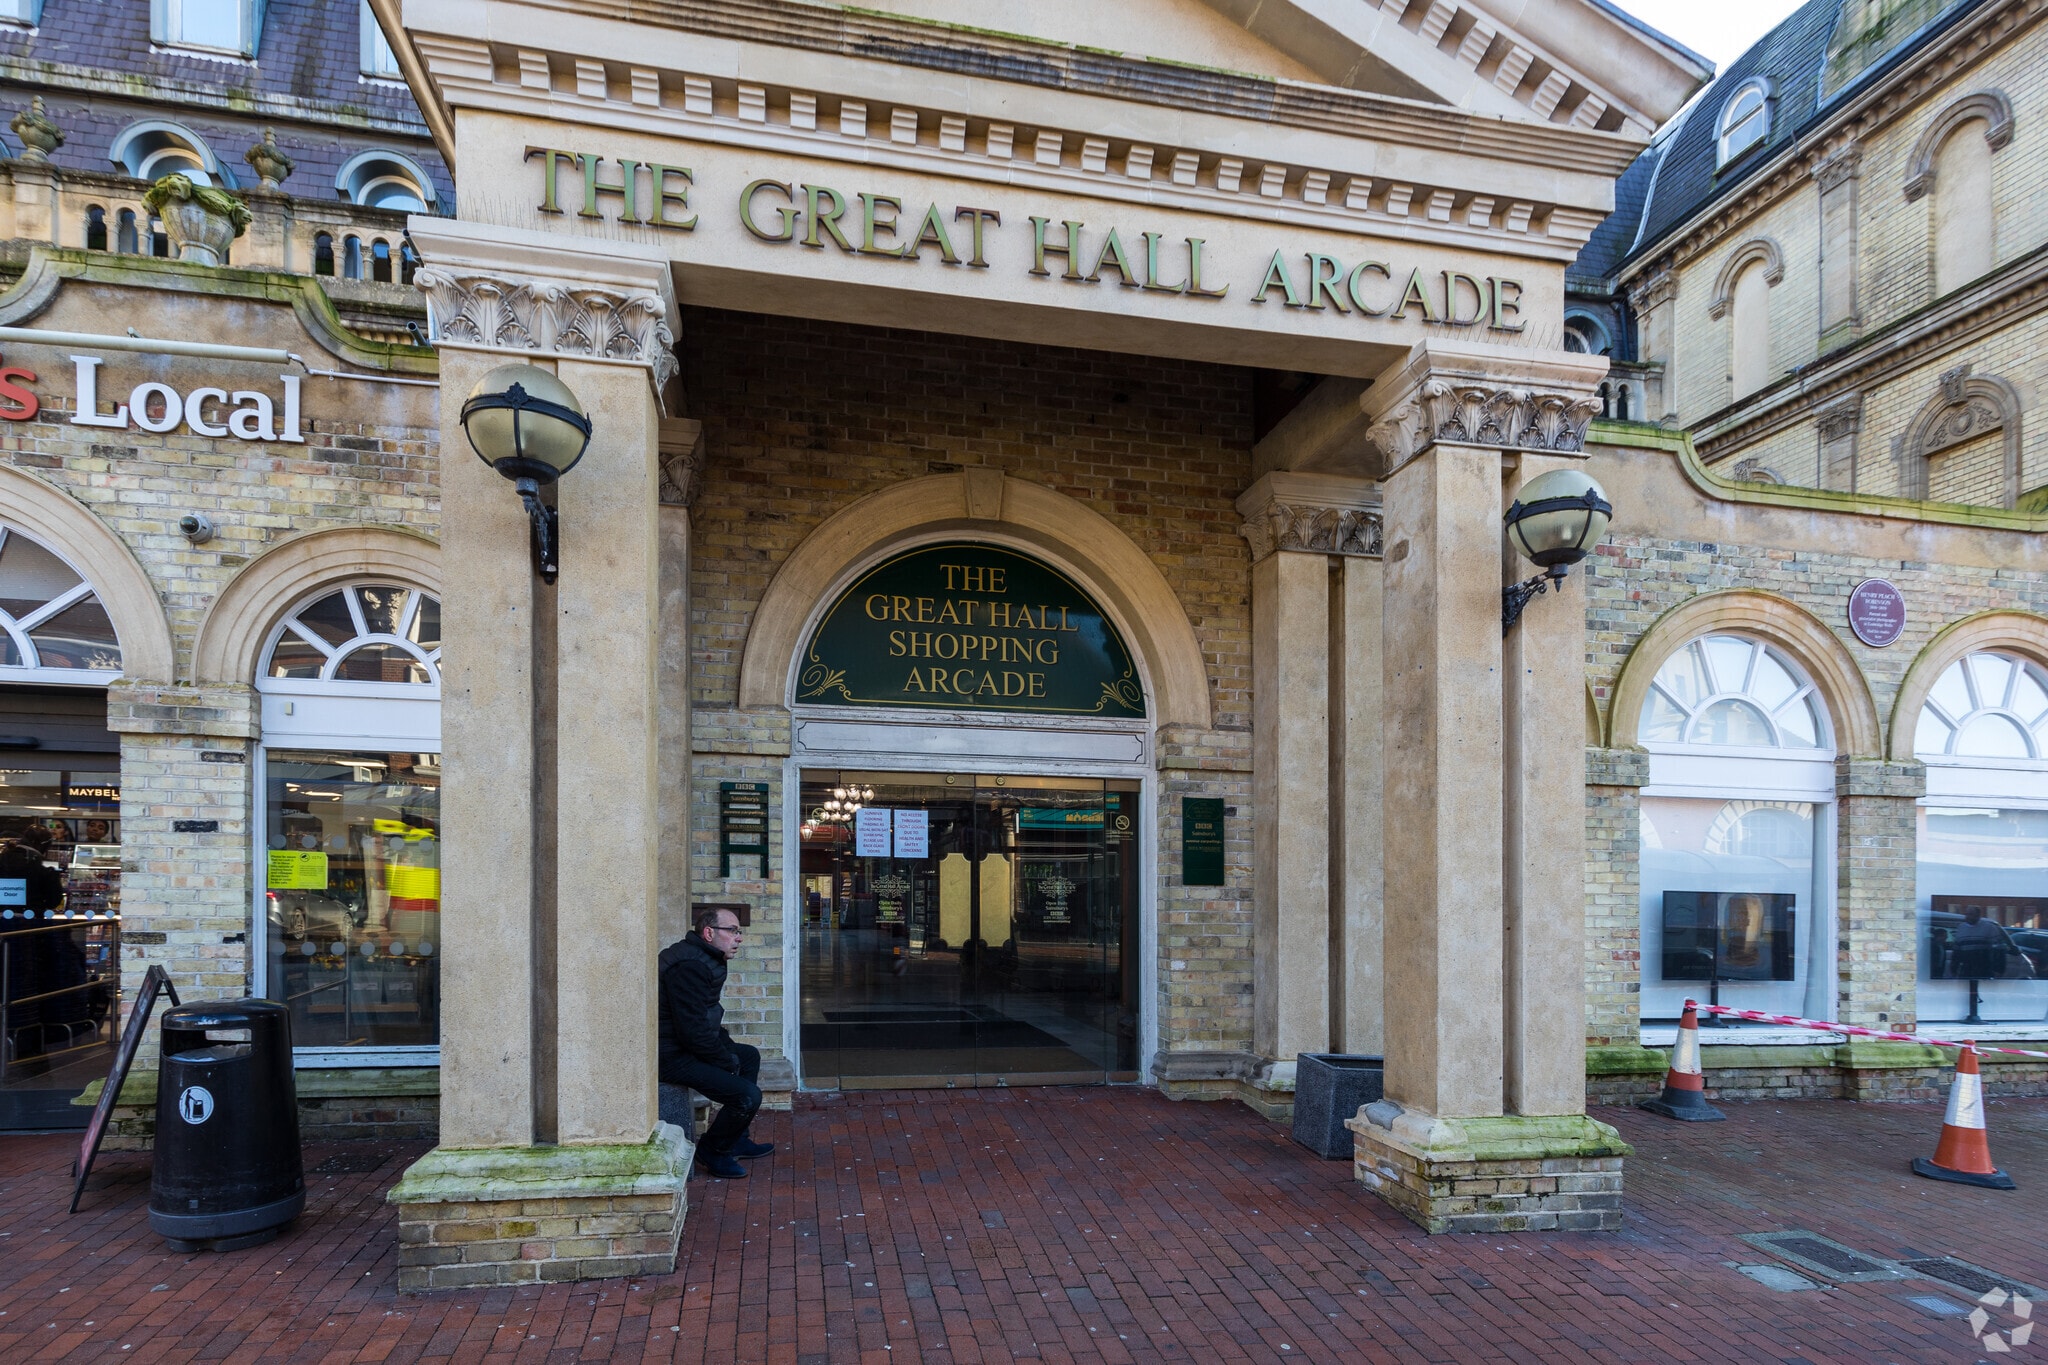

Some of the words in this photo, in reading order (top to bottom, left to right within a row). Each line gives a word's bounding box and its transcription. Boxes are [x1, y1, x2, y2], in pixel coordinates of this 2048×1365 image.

[523, 144, 699, 232] THE
[738, 177, 1002, 269] GREAT
[1028, 214, 1230, 299] HALL
[1250, 247, 1529, 333] ARCADE
[70, 354, 305, 443] Local
[939, 563, 1008, 594] THE
[865, 593, 980, 626] GREAT
[987, 600, 1079, 632] HALL
[889, 630, 1060, 665] SHOPPING
[902, 665, 1047, 698] ARCADE
[69, 788, 120, 797] MAYBEL
